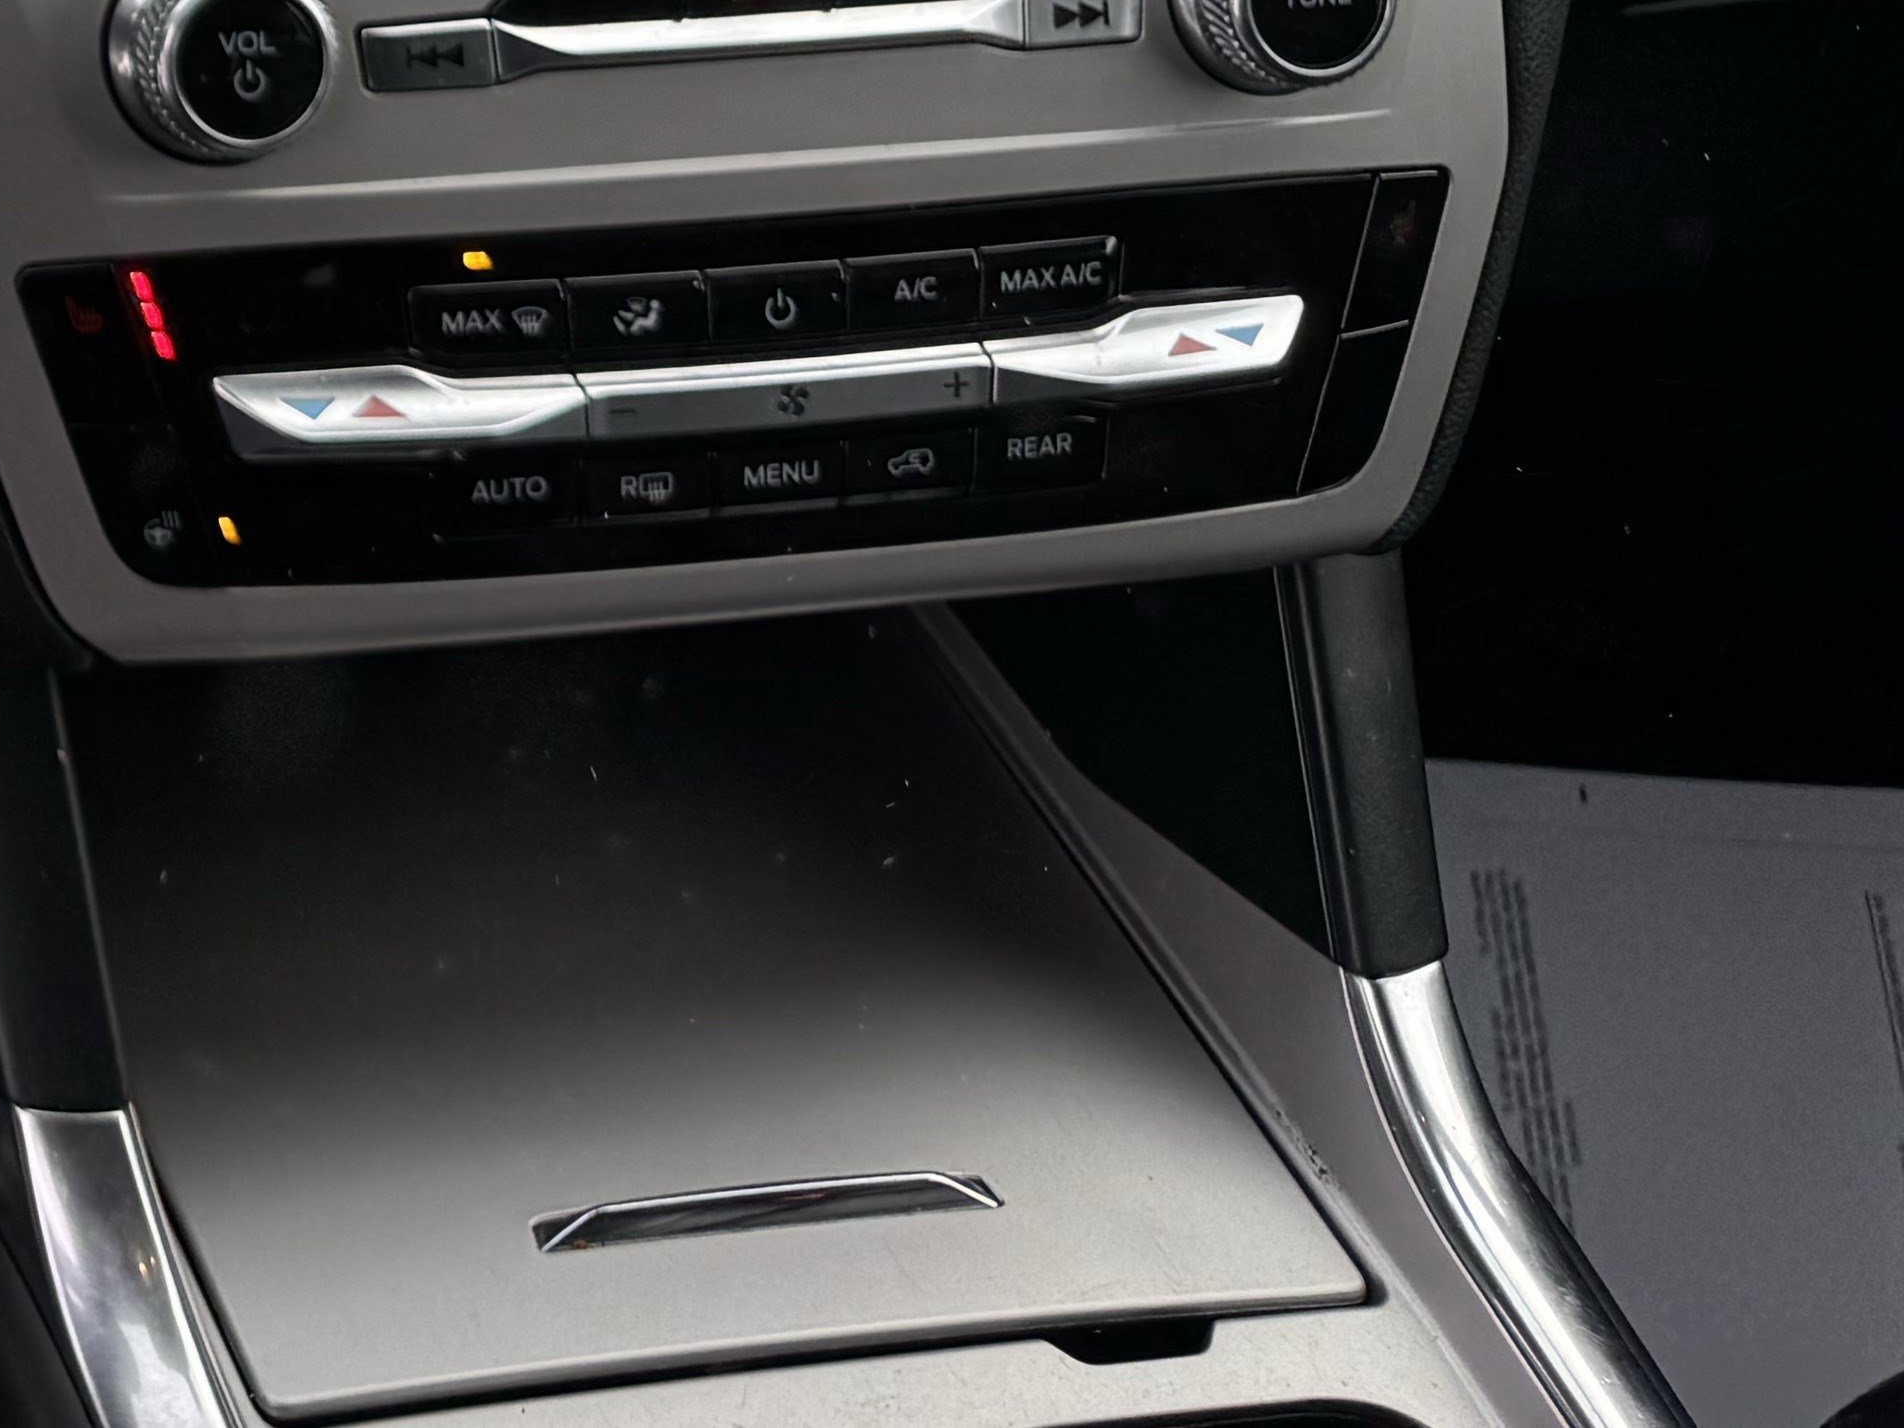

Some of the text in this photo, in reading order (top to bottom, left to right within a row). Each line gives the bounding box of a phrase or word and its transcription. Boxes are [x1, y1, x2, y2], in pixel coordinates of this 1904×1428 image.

[217, 28, 279, 57] VOL
[895, 275, 939, 303] A/C
[1000, 260, 1103, 294] MAX A/C
[442, 307, 502, 335] MAX
[1007, 432, 1074, 460] REAR
[744, 458, 822, 489] MENU
[471, 475, 548, 504] AUTO
